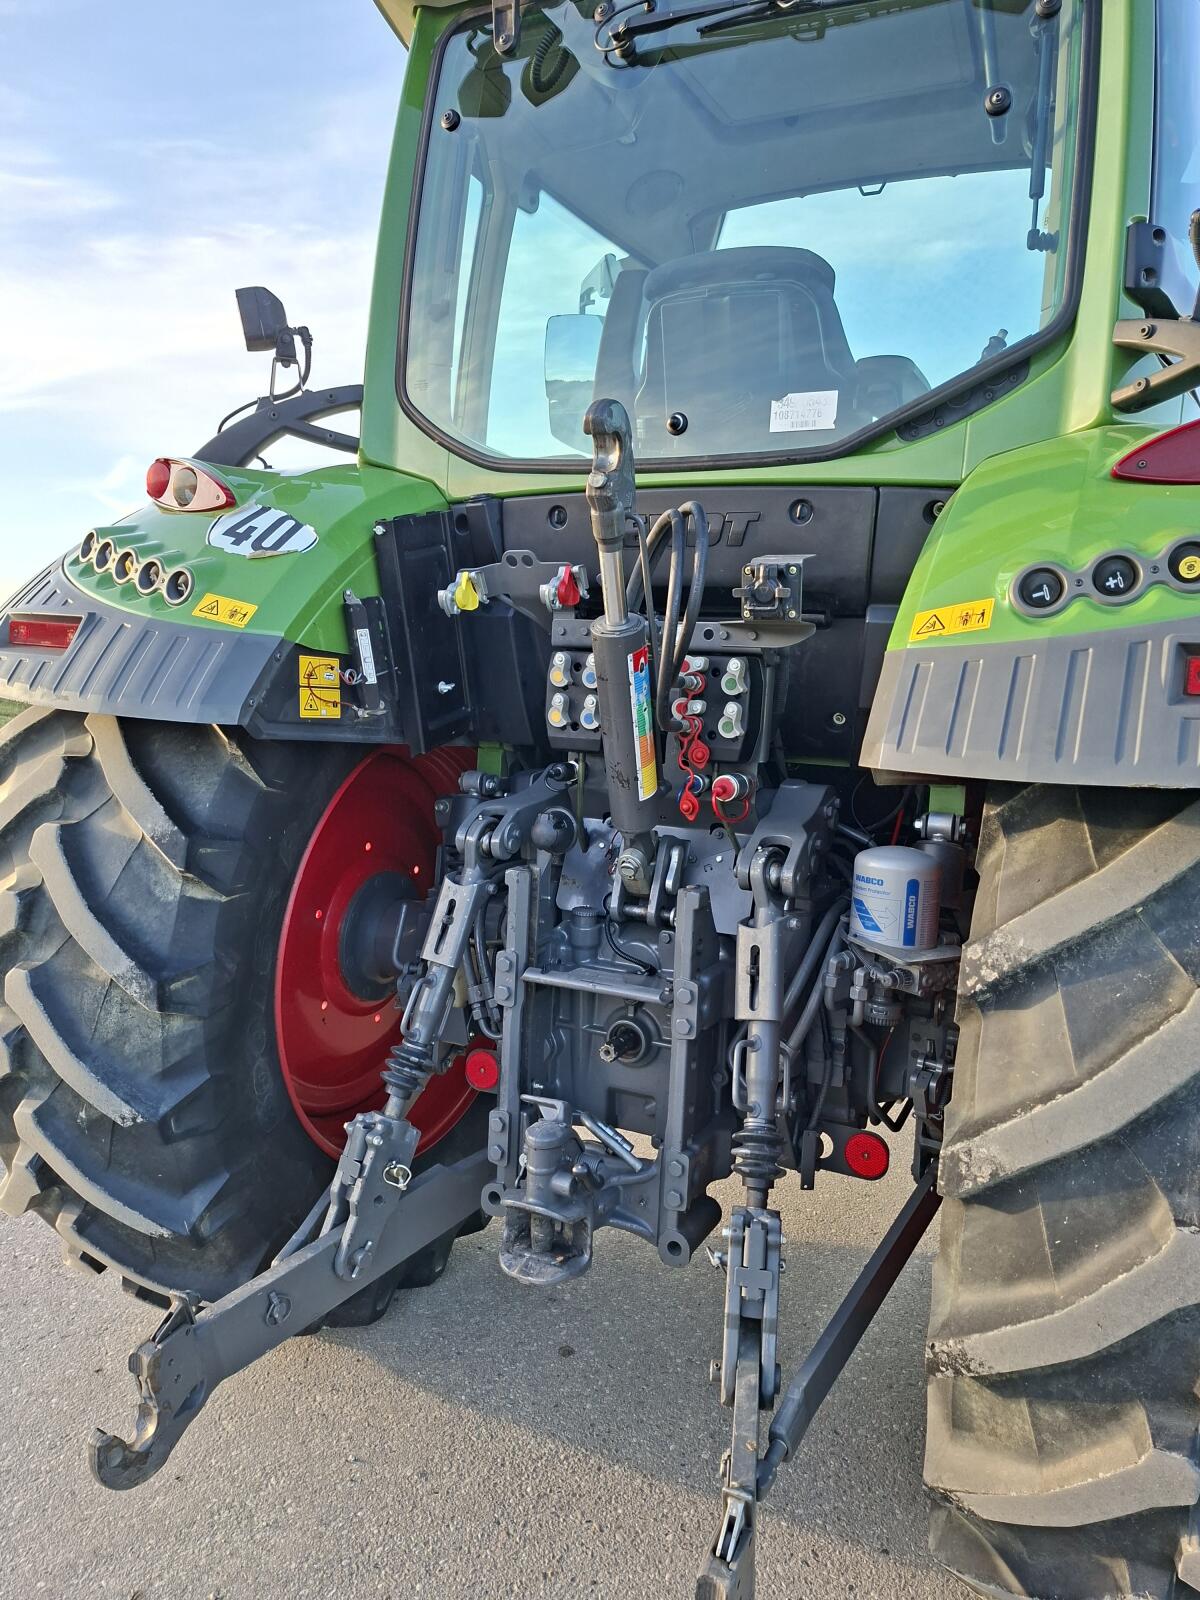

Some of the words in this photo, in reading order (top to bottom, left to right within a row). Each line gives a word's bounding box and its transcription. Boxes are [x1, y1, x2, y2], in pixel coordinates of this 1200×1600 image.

[222, 506, 304, 551] 40
[855, 873, 884, 887] WABCO
[906, 895, 916, 929] WABCO
